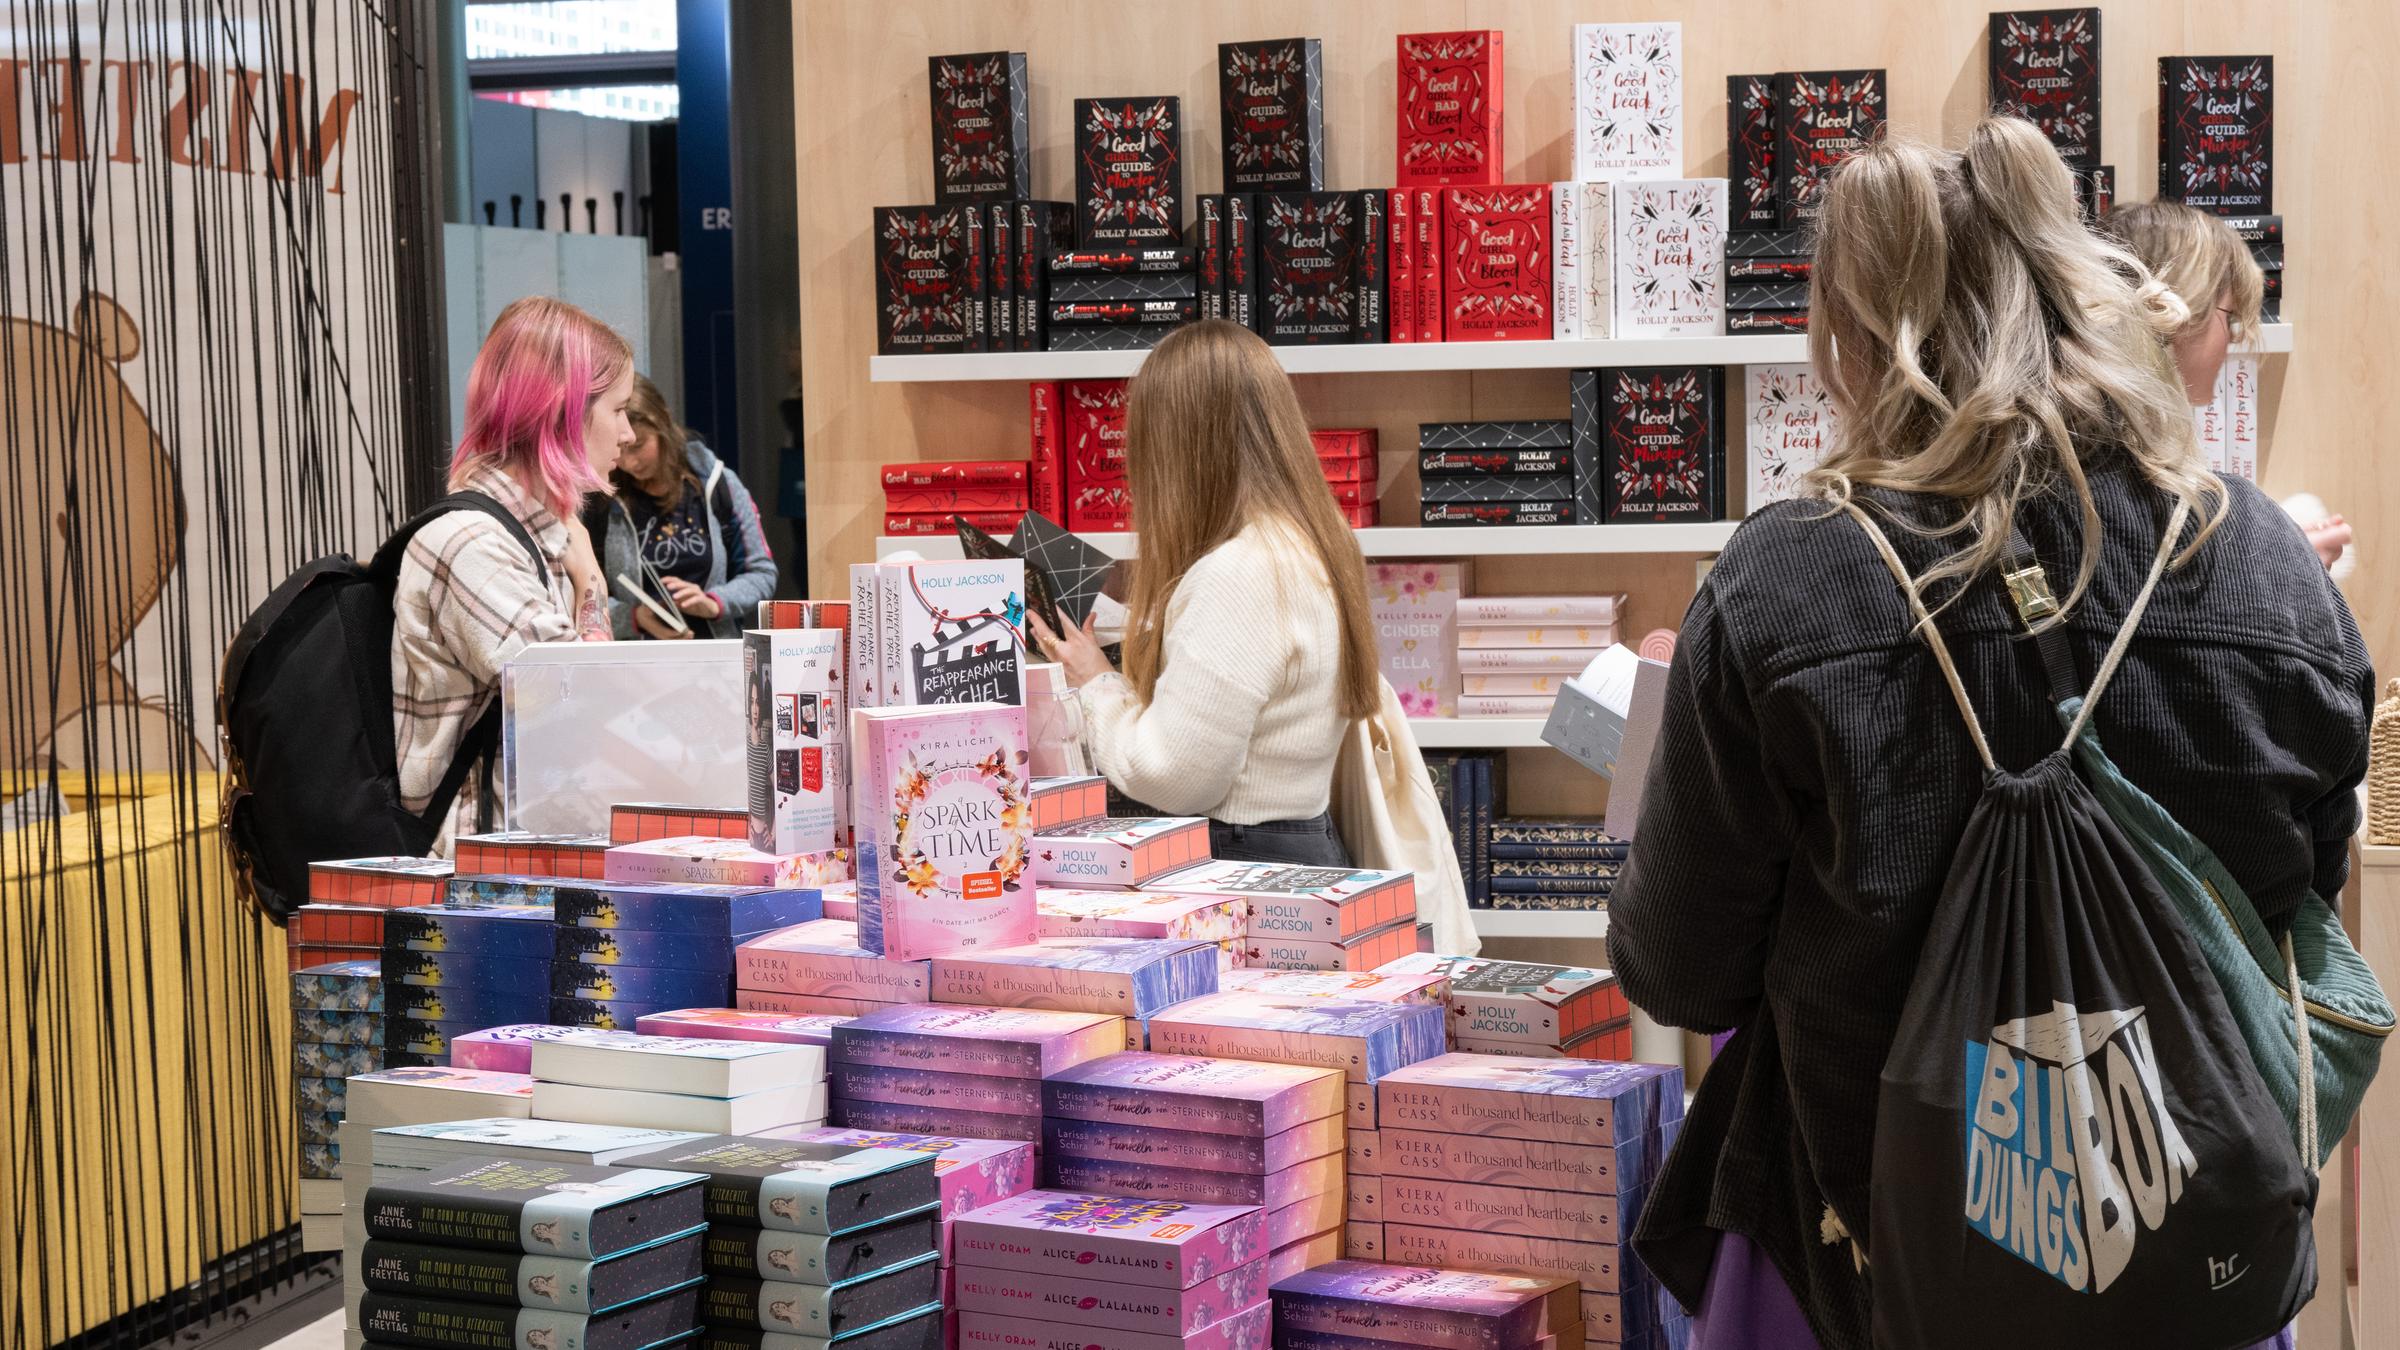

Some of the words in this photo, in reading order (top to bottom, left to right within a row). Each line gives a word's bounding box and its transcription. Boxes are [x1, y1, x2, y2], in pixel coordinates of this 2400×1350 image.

[2027, 77, 2070, 89] GUIDE
[2206, 96, 2241, 115] Good
[2205, 125, 2246, 135] GUIDE
[1112, 135, 1146, 153] Good
[1111, 162, 1152, 172] GUIDE
[2186, 196, 2218, 206] HOLLY
[2220, 195, 2262, 205] JACKSON
[1095, 229, 1126, 238] HOLLY
[1128, 228, 1169, 237] JACKSON
[1656, 227, 1689, 244] Good
[1668, 225, 1681, 234] AS
[1480, 229, 1514, 246] Good
[1143, 250, 1176, 260] HOLLY
[1668, 244, 1682, 253] AS
[1488, 254, 1516, 265] BAD
[1654, 246, 1694, 266] Dead
[1139, 261, 1180, 271] JACKSON
[1291, 258, 1332, 268] GUIDE
[908, 269, 946, 280] GUIDE
[1144, 302, 1177, 311] HOLLY
[1140, 313, 1181, 322] JACKSON
[1462, 320, 1493, 329] HOLLY
[1496, 319, 1538, 328] JACKSON
[1636, 316, 1669, 325] HOLLY
[1671, 315, 1714, 324] JACKSON
[1275, 326, 1307, 335] HOLLY
[1308, 324, 1350, 334] JACKSON
[893, 335, 922, 344] HOLLY
[924, 334, 964, 343] JACKSON
[1639, 407, 1675, 426] Good
[1784, 412, 1818, 428] Good
[1797, 409, 1810, 418] AS
[1797, 427, 1811, 435] AS
[1639, 434, 1681, 445] GUIDE
[1782, 431, 1821, 450] Dead
[1518, 451, 1552, 461] HOLLY
[1514, 462, 1556, 472] JACKSON
[885, 470, 908, 484] Good
[1520, 503, 1553, 512] HOLLY
[1621, 503, 1654, 513] HOLLY
[1656, 502, 1699, 512] JACKSON
[1516, 514, 1557, 523] JACKSON
[921, 577, 953, 589] HOLLY
[955, 574, 1005, 587] JACKSON
[1413, 612, 1442, 620] ORAM
[1380, 624, 1440, 638] CINDER
[779, 648, 805, 657] HOLLY
[930, 665, 945, 674] THE
[1392, 656, 1431, 670] ELLA
[923, 658, 1015, 694] REAPPEARANCE
[944, 688, 954, 696] OF
[920, 739, 950, 751] KIRA
[957, 736, 995, 748] LICHT
[922, 799, 998, 830] SPARK
[921, 827, 1002, 859] TIME
[1062, 850, 1097, 862] HOLLY
[1535, 847, 1615, 859] MORRIGHAN
[628, 865, 646, 873] KIRA
[718, 867, 750, 883] TIME
[1055, 863, 1108, 876] JACKSON
[1536, 879, 1616, 892] MORRIGHAN
[1265, 905, 1301, 918] HOLLY
[1257, 918, 1313, 932] JACKSON
[1271, 948, 1307, 961] HOLLY
[748, 958, 788, 970] KIERA
[752, 971, 786, 984] CASS
[795, 968, 803, 978] a
[805, 966, 853, 982] thousand
[854, 971, 909, 988] heartbeats
[943, 968, 986, 982] KIERA
[947, 982, 982, 996] CASS
[993, 980, 1001, 989] a
[1002, 977, 1053, 994] thousand
[1055, 981, 1113, 999] heartbeats
[1478, 1005, 1516, 1020] HOLLY
[1469, 1019, 1529, 1035] JACKSON
[845, 1036, 875, 1047] Larissa
[1162, 1031, 1208, 1045] KIERA
[954, 1051, 1022, 1064] STERNENSTAUB
[1217, 1042, 1225, 1052] a
[1226, 1041, 1281, 1059] thousand
[1283, 1044, 1346, 1064] heartbeats
[1056, 1089, 1088, 1101] Larissa
[1392, 1092, 1441, 1107] KIERA
[1106, 1097, 1152, 1116] Funkeln
[1171, 1107, 1243, 1121] STERNENSTAUB
[1397, 1107, 1438, 1121] CASS
[1451, 1104, 1461, 1116] a
[1462, 1102, 1520, 1122] thousand
[1523, 1106, 1590, 1127] heartbeats
[1396, 1187, 1445, 1202] KIERA
[380, 1205, 405, 1218] ANNE
[1401, 1202, 1441, 1217] CASS
[1454, 1201, 1463, 1211] a
[1464, 1199, 1524, 1218] thousand
[1527, 1203, 1594, 1224] heartbeats
[1965, 1126, 2090, 1292] DUNGS
[373, 1216, 413, 1230] FREYTAG
[962, 1239, 996, 1251] KELLY
[999, 1243, 1032, 1255] ORAM
[1042, 1248, 1076, 1261] ALICE
[1097, 1253, 1159, 1269] LALALAND
[377, 1258, 402, 1271] ANNE
[2207, 1252, 2242, 1286] hr
[370, 1268, 410, 1282] FREYTAG
[964, 1284, 997, 1297] KELLY
[1001, 1288, 1033, 1300] ORAM
[1044, 1293, 1078, 1306] ALICE
[1098, 1299, 1160, 1316] LALALAND
[1282, 1299, 1315, 1311] Larissa
[1283, 1310, 1314, 1323] Schira
[1334, 1309, 1383, 1328] Funkeln
[1403, 1319, 1478, 1336] STERNENSTAUB
